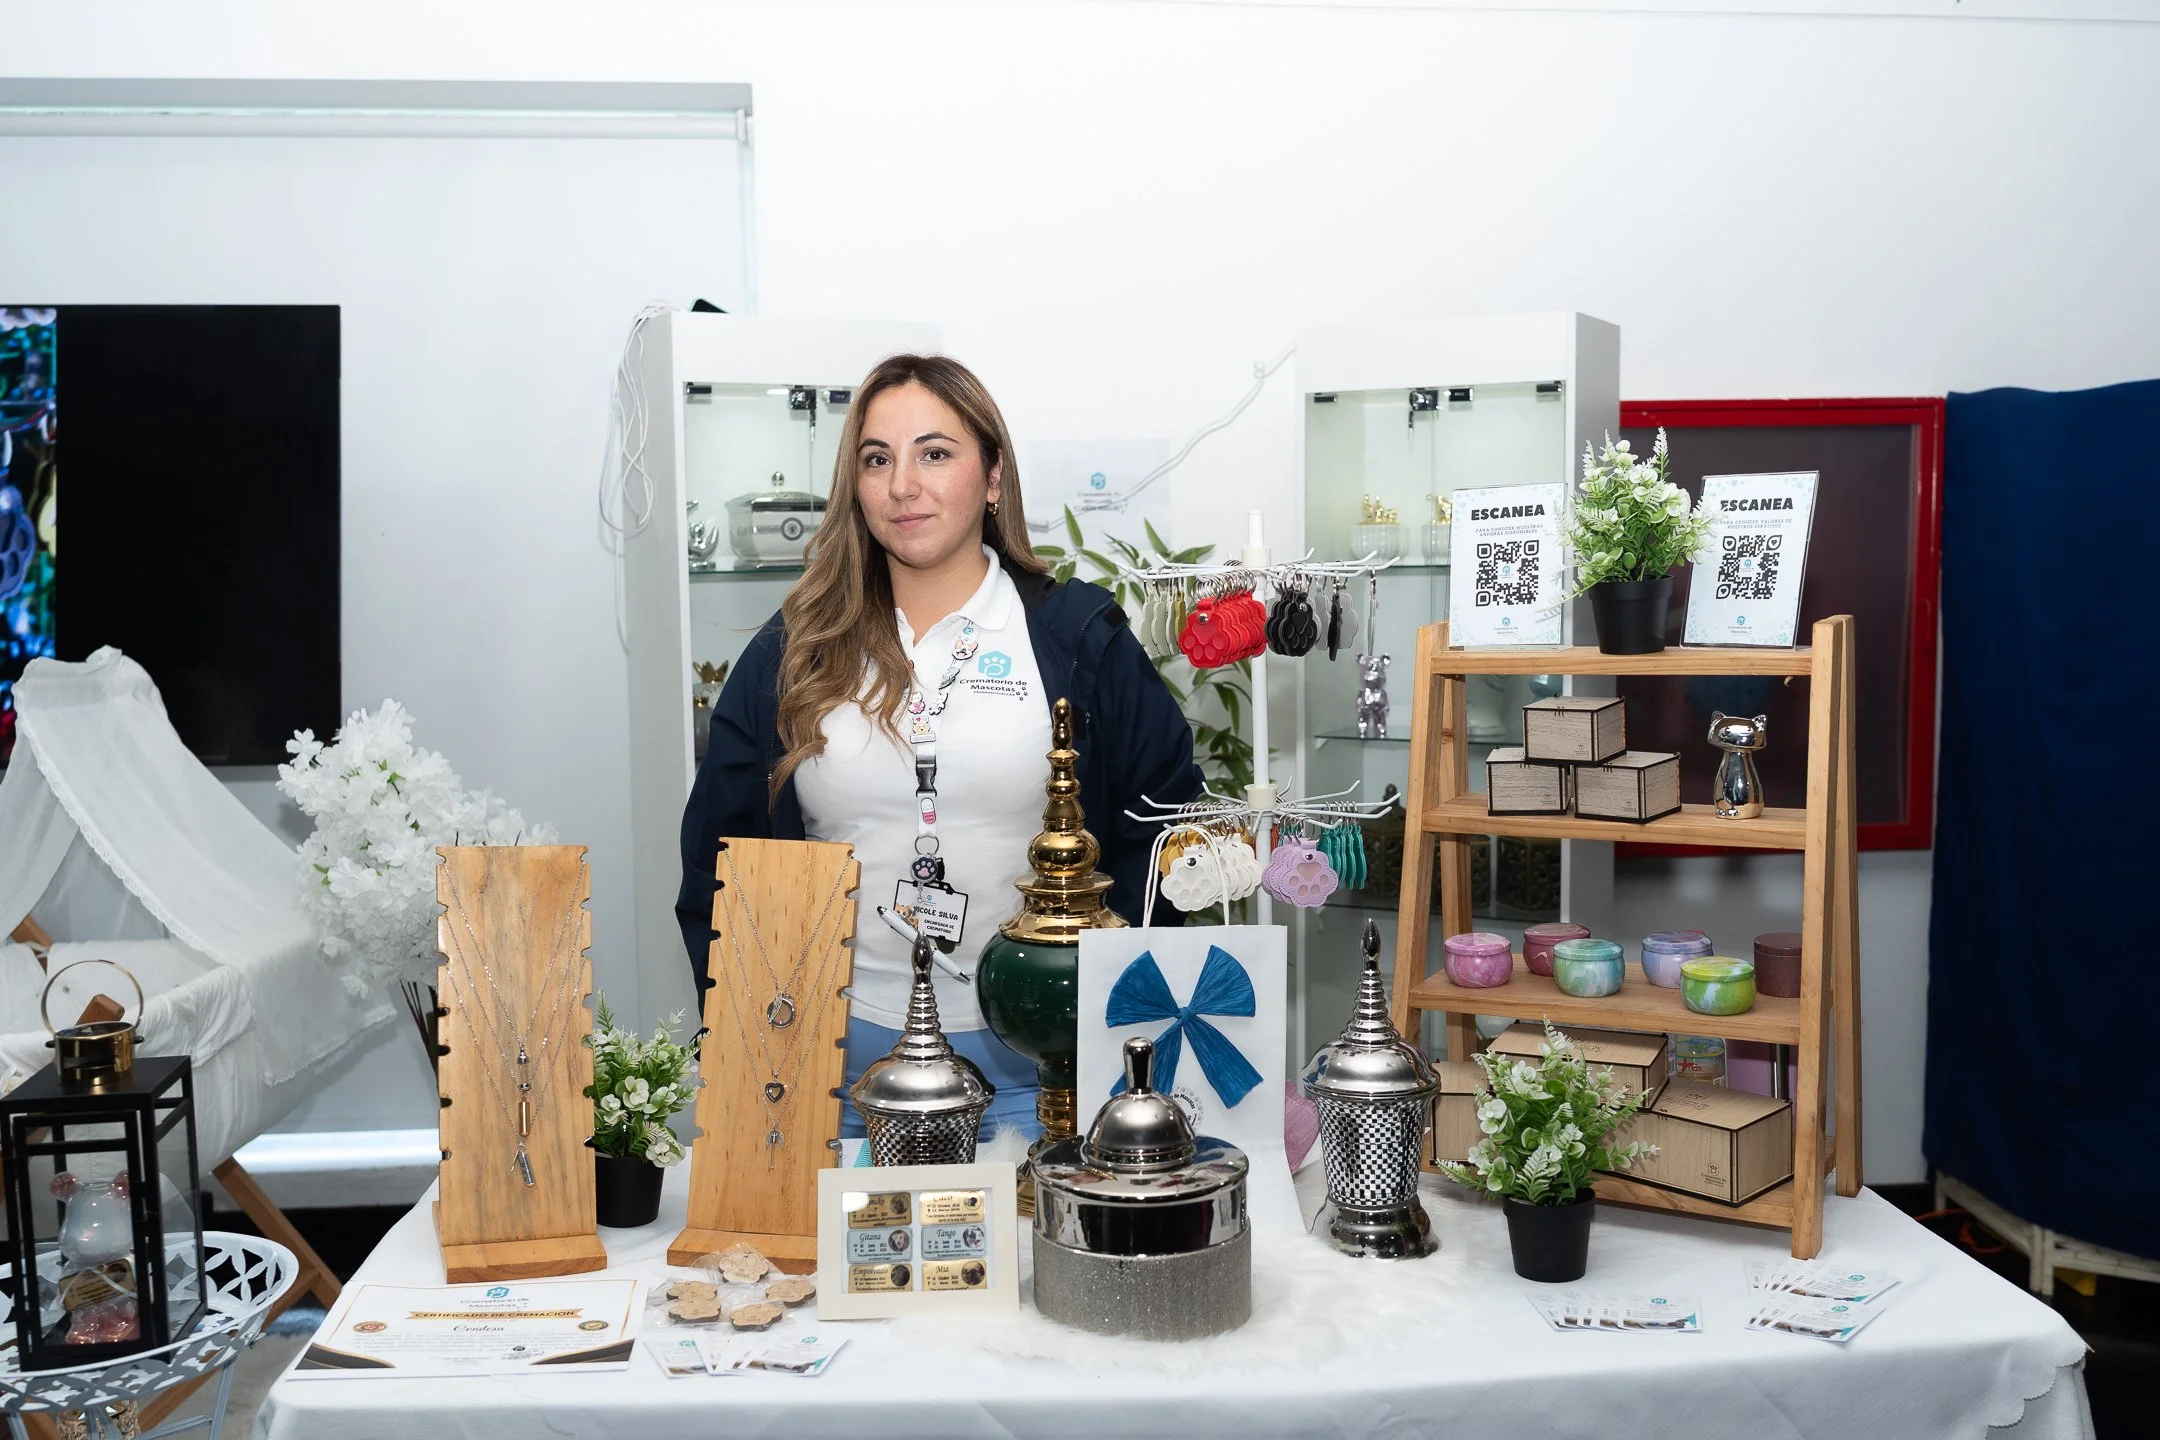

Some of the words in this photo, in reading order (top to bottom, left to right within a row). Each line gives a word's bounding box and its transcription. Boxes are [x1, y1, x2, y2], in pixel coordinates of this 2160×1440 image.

[1720, 498, 1793, 511] ESCANEA
[1471, 504, 1545, 520] ESCANEA
[970, 684, 1015, 692] Mascotas
[938, 911, 959, 921] SILVA
[859, 1232, 881, 1243] Gitana
[936, 1228, 956, 1239] Tango
